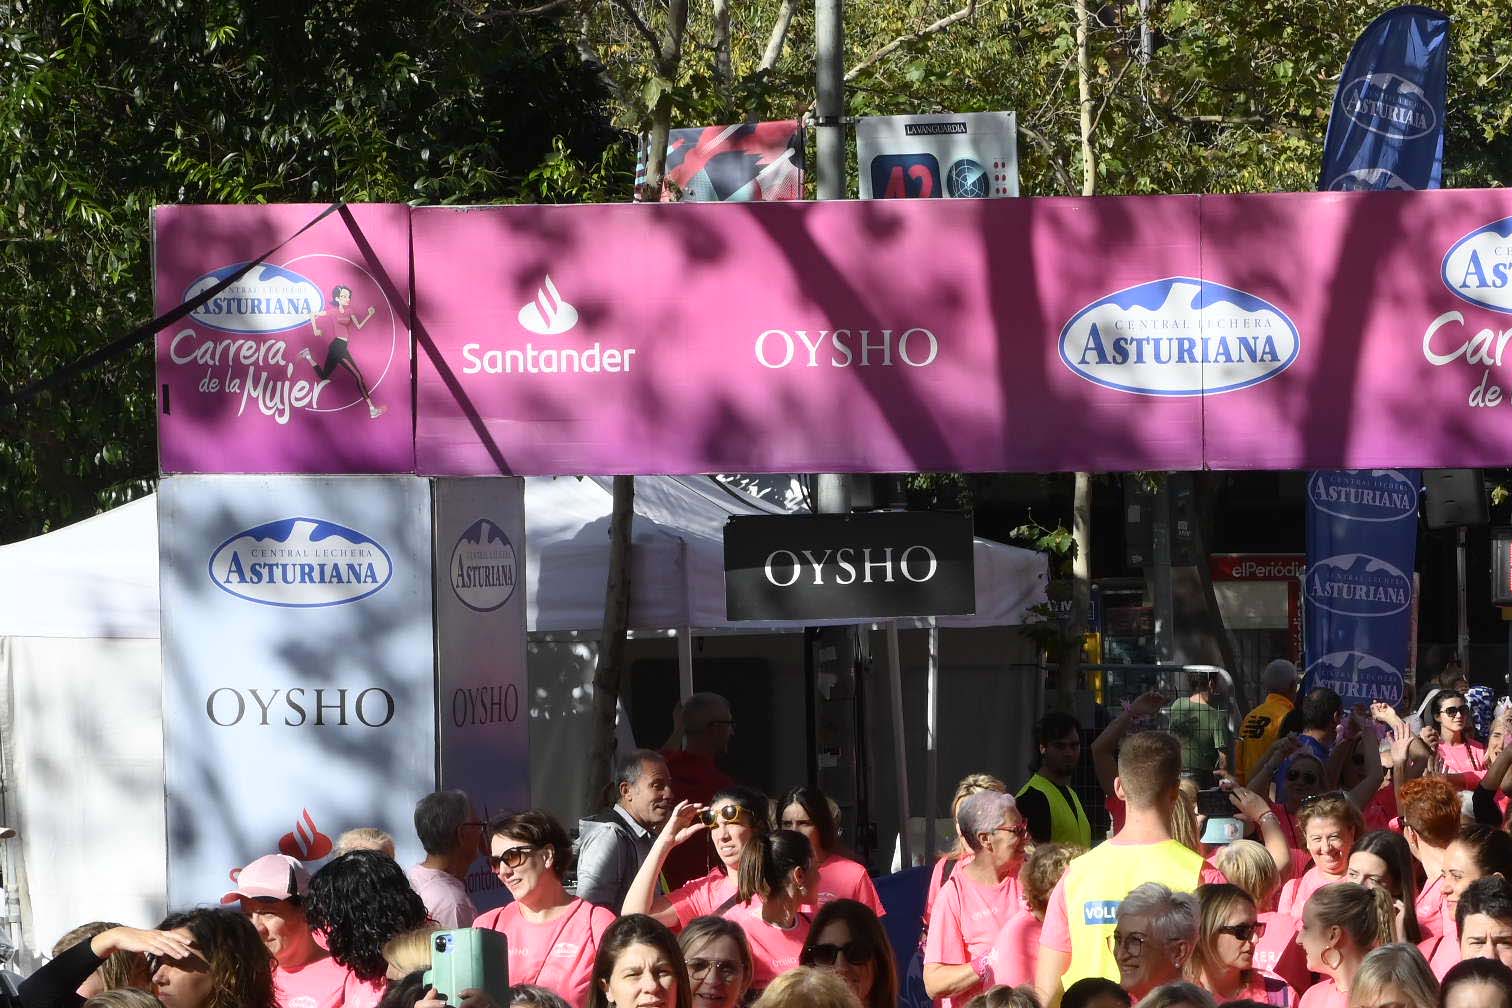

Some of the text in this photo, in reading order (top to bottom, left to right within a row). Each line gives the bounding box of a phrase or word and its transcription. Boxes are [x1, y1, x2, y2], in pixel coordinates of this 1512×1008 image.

[1114, 317, 1274, 331] CENTRAL LECHERA
[170, 328, 287, 366] Carrera
[463, 342, 637, 376] Santander
[754, 327, 938, 369] OYSHO
[1077, 322, 1282, 367] ASTURIANA
[199, 362, 331, 425] de la Mujer
[1468, 371, 1502, 407] de
[1314, 476, 1411, 510] ASTURIANA
[224, 551, 379, 585] ASTURIANA
[251, 548, 373, 558] CENTRAL LECHERA
[764, 545, 938, 589] OYSHO
[1232, 561, 1305, 578] elPeriódi
[456, 554, 514, 589] ASTURIANA
[1311, 574, 1406, 604] ASTURIANA
[205, 687, 396, 728] OYSHO
[452, 683, 519, 728] OYSHO
